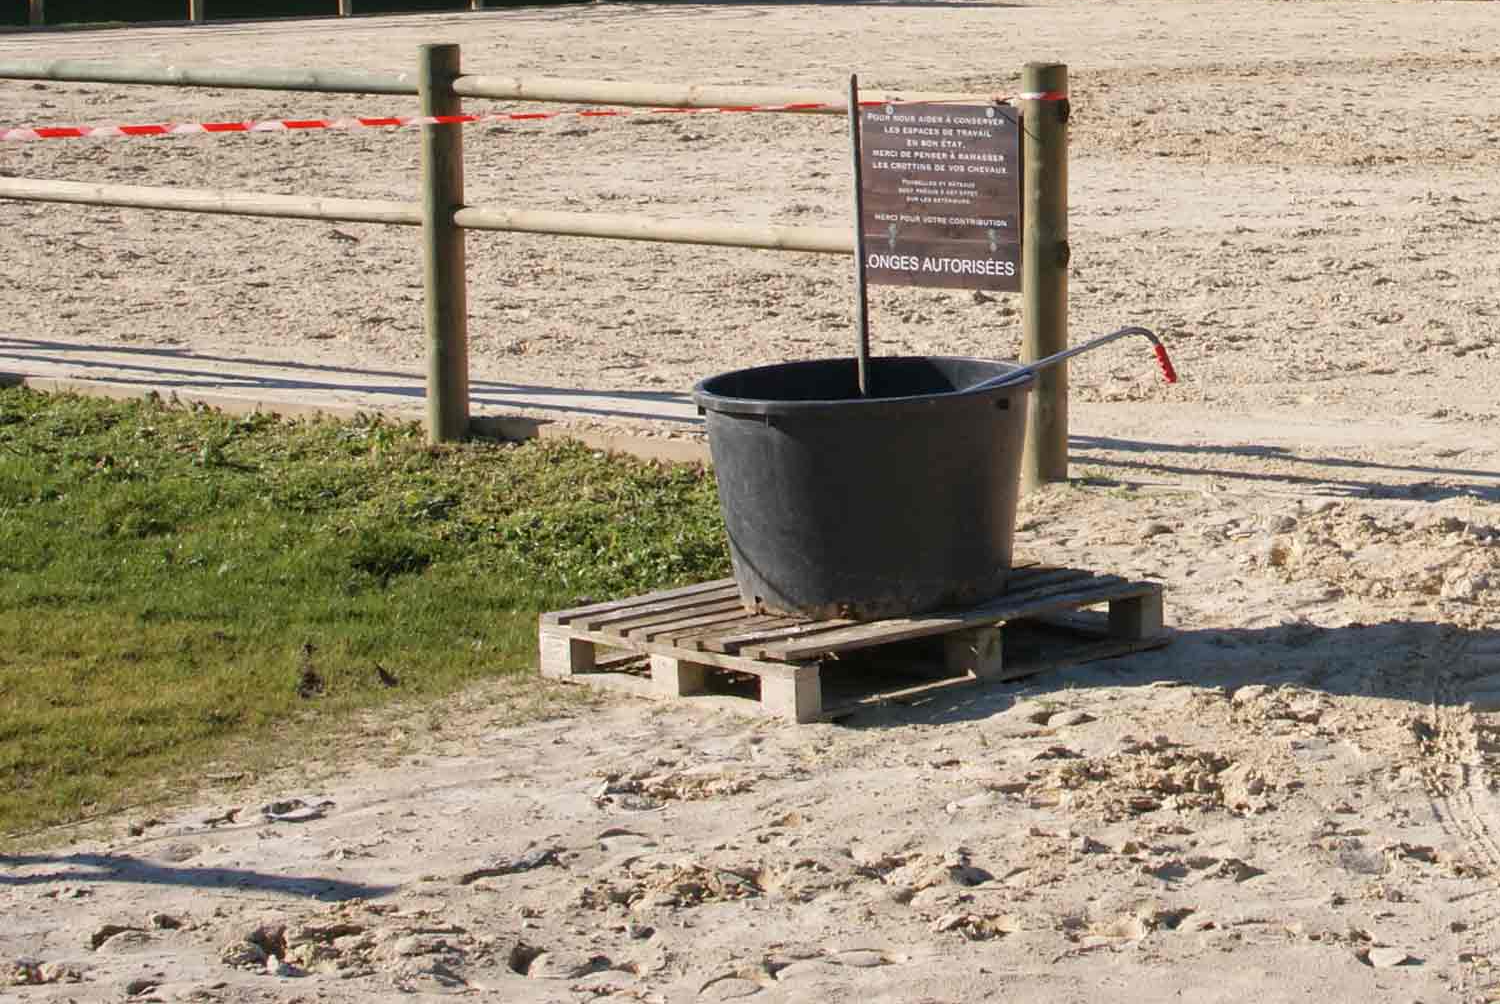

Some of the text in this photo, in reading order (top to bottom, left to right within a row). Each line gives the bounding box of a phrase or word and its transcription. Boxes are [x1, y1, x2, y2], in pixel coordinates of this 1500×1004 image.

[867, 112, 890, 122] POUR
[893, 115, 915, 123] NOUS
[918, 115, 943, 124] AIDER
[953, 116, 1005, 126] CONSERVER
[884, 126, 992, 138] LES ESPACES DE TRAVAIL
[907, 139, 918, 147] EN
[921, 139, 939, 147] BON
[872, 149, 898, 157] MERCI
[900, 150, 911, 158] DE
[914, 151, 947, 160] PENSER
[958, 153, 1005, 162] RAMASSER
[872, 161, 888, 169] LES
[890, 162, 932, 171] CROTTINS
[934, 163, 945, 172] DE
[949, 164, 964, 172] VOS
[874, 213, 1007, 228] MERCI POUR VOTRE CONTRIBUTION
[865, 253, 1015, 277] ONGES AUTORISÉES
